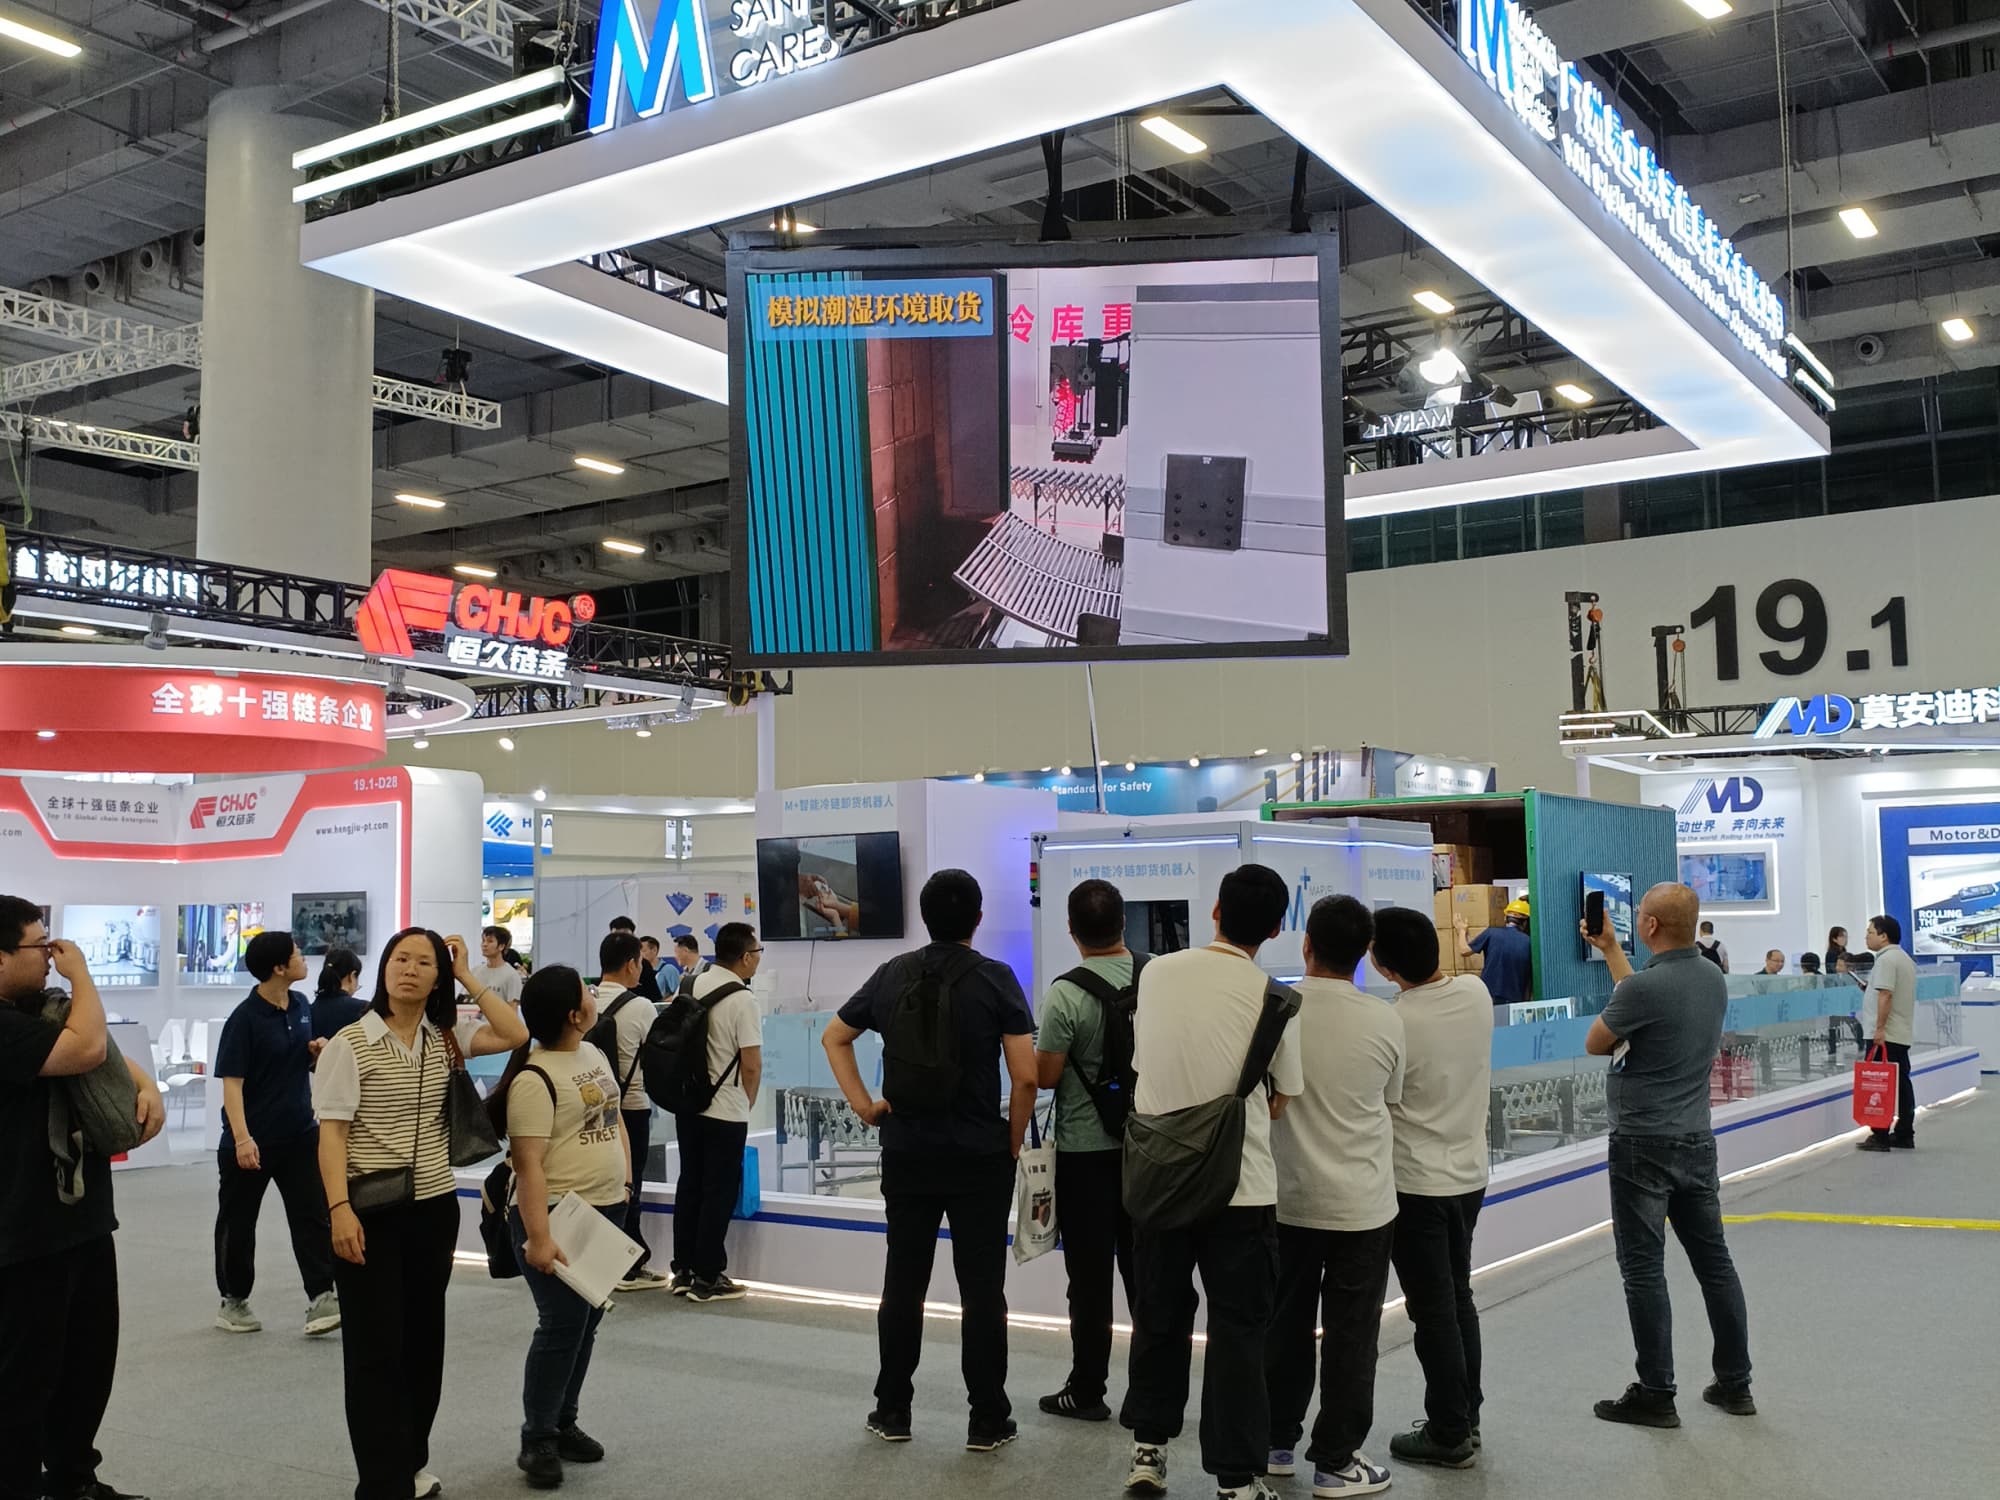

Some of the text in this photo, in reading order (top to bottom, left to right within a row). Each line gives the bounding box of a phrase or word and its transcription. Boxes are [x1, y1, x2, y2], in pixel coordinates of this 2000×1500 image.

[767, 290, 982, 329] 模拟潮湿环境取货
[454, 583, 573, 647] CHJC
[1690, 578, 1909, 681] 19.1
[447, 635, 568, 679] 恒久链条
[151, 682, 374, 732] 全球十强链条企业
[353, 776, 398, 791] 19.1-D28
[1052, 784, 1101, 795] Standard
[1104, 784, 1118, 792] for
[1119, 781, 1152, 793] Safety
[47, 796, 160, 815] 全球十强链条企业
[219, 793, 258, 813] CHJC
[784, 794, 894, 813] M+智能冷链卸货机器人
[216, 812, 257, 828] 恒久链条
[315, 821, 390, 837] www.hengjiu-pt.com
[1675, 817, 1786, 834] 动世界 奔向未来
[1072, 862, 1195, 879] M+智能冷链卸货机器人
[1918, 909, 1963, 919] ROLLING
[571, 1066, 606, 1087] SESAME
